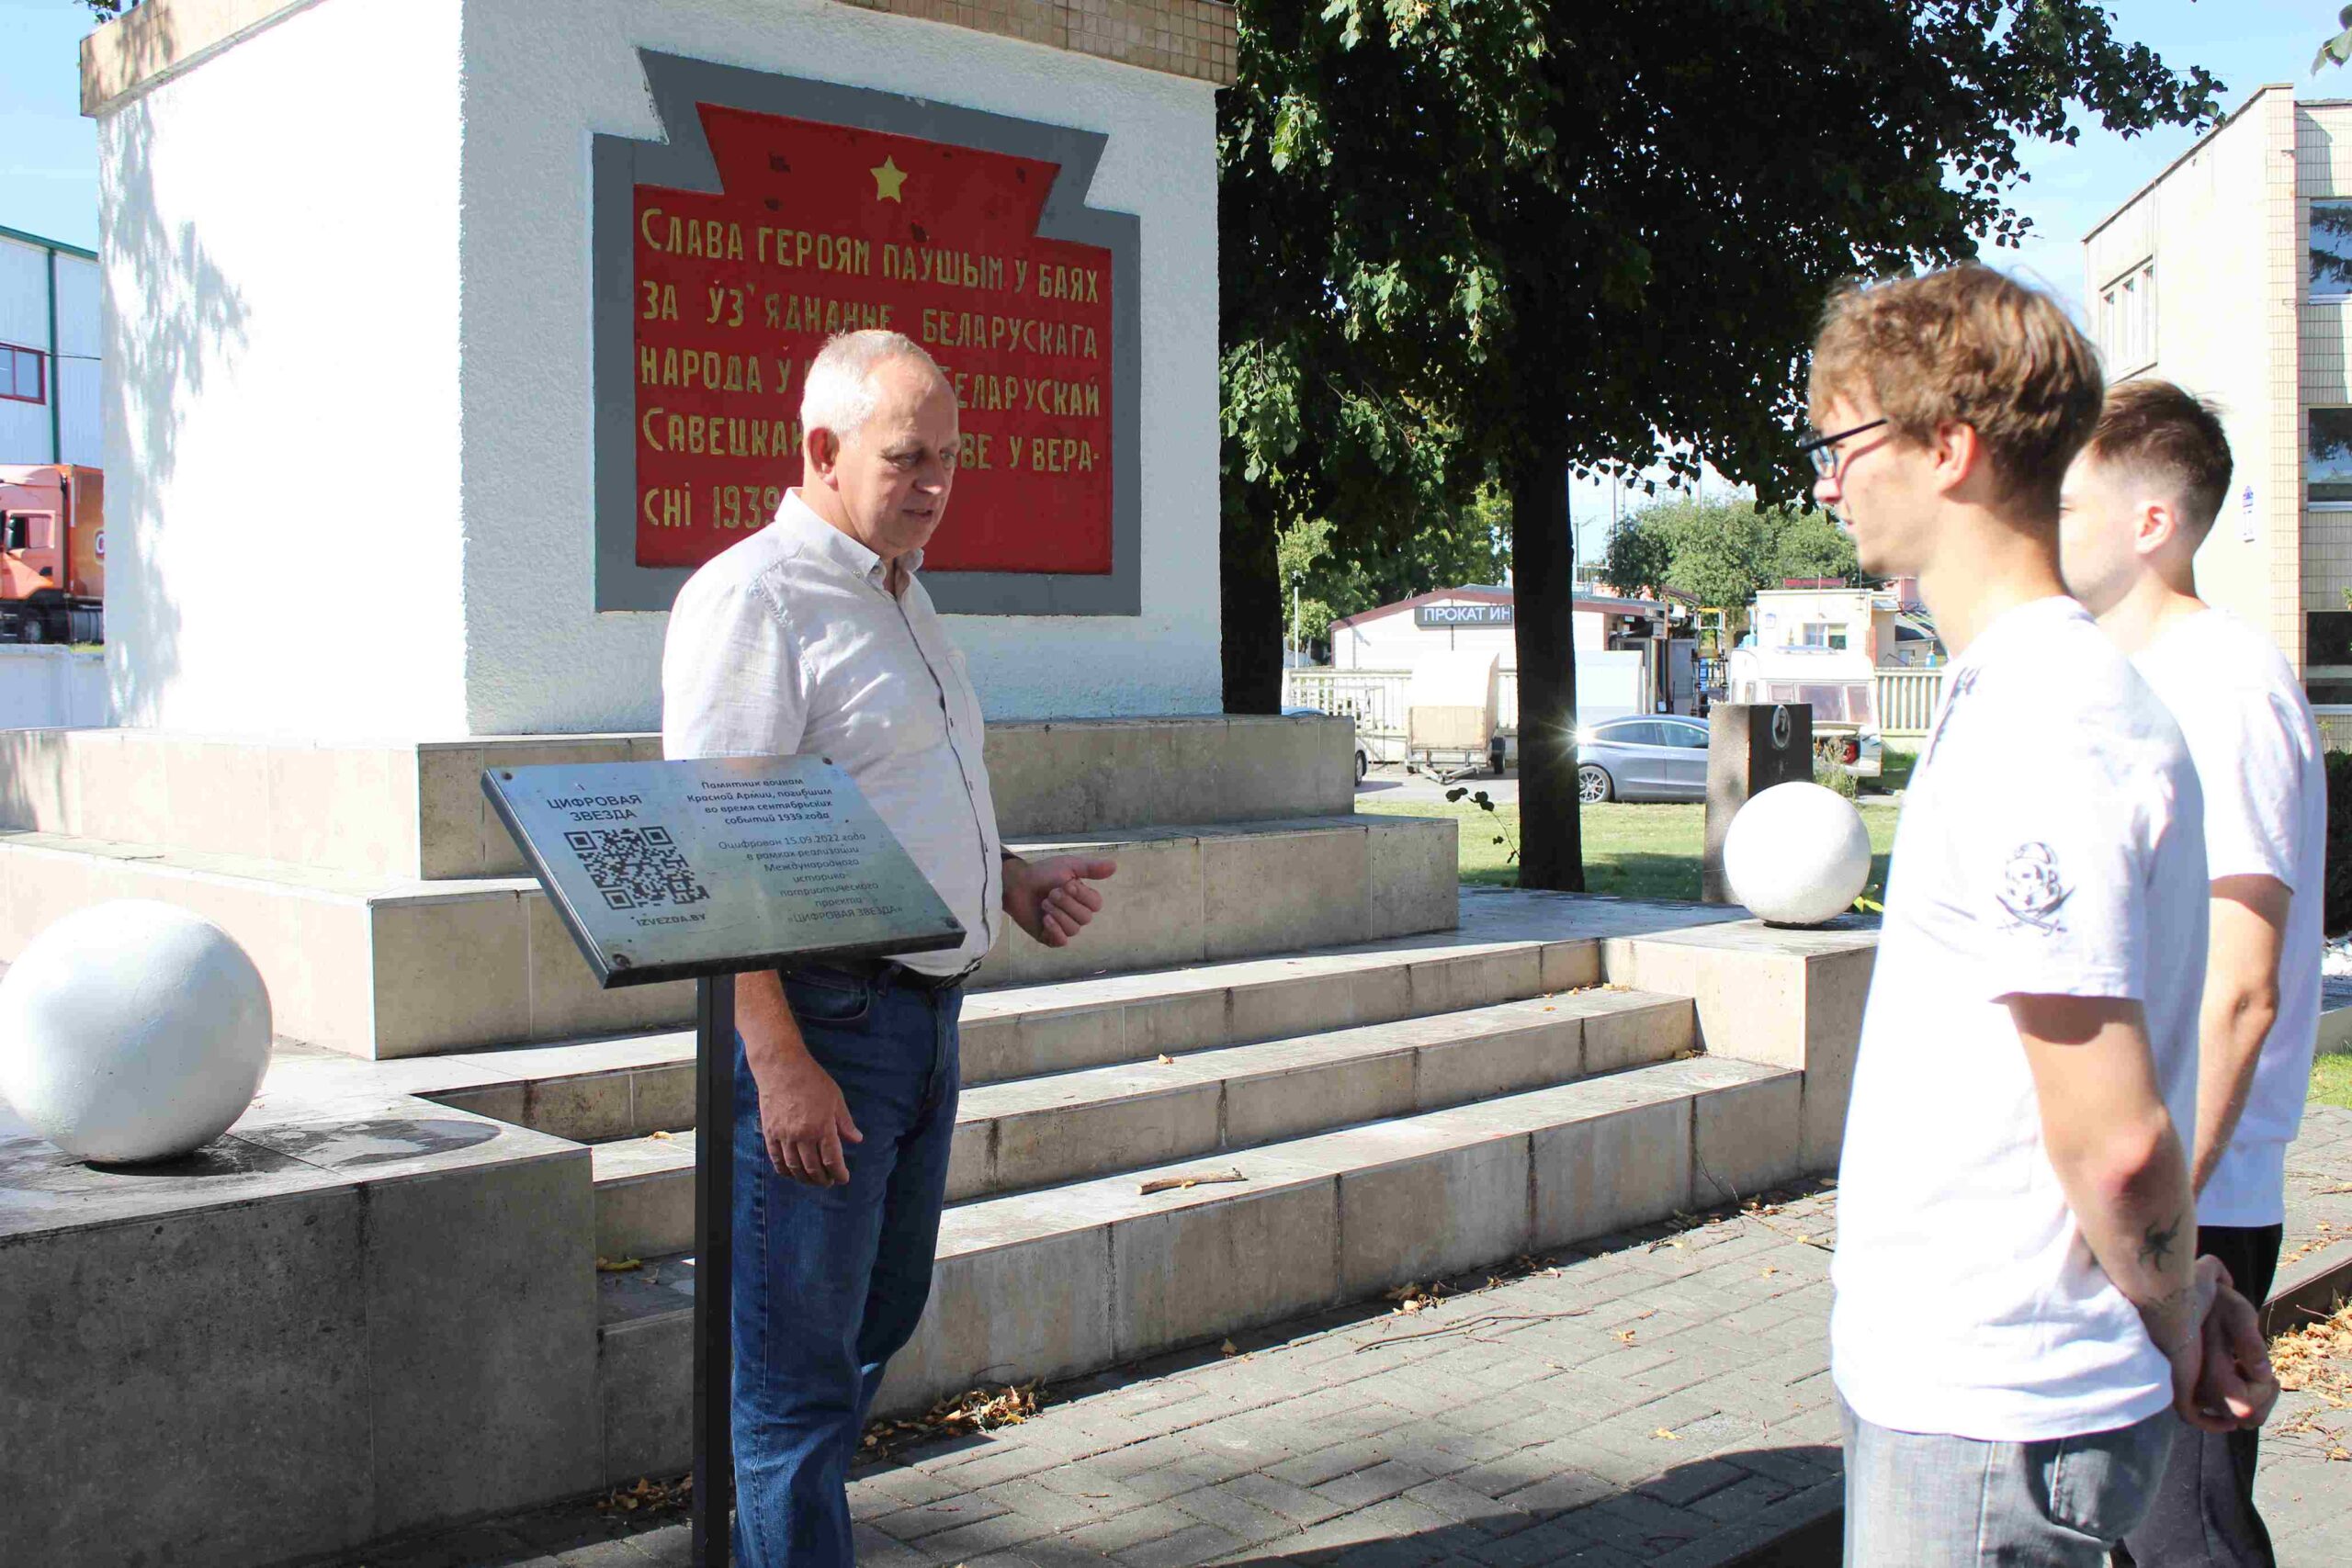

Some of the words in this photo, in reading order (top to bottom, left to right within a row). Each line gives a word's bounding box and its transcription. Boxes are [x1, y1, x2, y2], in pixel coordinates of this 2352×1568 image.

[641, 208, 743, 261] СЛАВА
[757, 226, 870, 276] ГЕРОЯМ
[1014, 259, 1028, 294] У
[1038, 263, 1099, 304] БАЯХ
[642, 279, 679, 321] ЗА
[922, 309, 1098, 359] БЕЛАРУСКАГА
[640, 345, 763, 393] НАРОДА
[941, 366, 1100, 417] ЕЛАРУСКАЙ
[1010, 435, 1023, 468] У
[1424, 607, 1486, 621] ПРОКАТ
[701, 781, 760, 790] Памятник
[763, 777, 804, 786] воинам
[547, 795, 642, 809] ЦИФРОВАЯ
[686, 791, 734, 803] Красной
[736, 791, 775, 801] Армии,
[777, 787, 832, 799] погибшим
[720, 805, 755, 814] время
[757, 799, 832, 811] сентябрьских
[570, 808, 638, 822] ЗВЕЗДА
[724, 814, 775, 825] событий
[778, 813, 802, 821] 1939
[805, 811, 830, 820] года
[718, 836, 782, 850] Оцифрован
[785, 834, 839, 846] 15.09.2022
[842, 831, 865, 841] года
[757, 851, 795, 861] рамках
[798, 845, 859, 858] реализации
[764, 858, 860, 873] Международного
[780, 882, 879, 897] патриотического
[815, 897, 863, 908] проекта
[637, 912, 707, 927] IZVEZDA.BY
